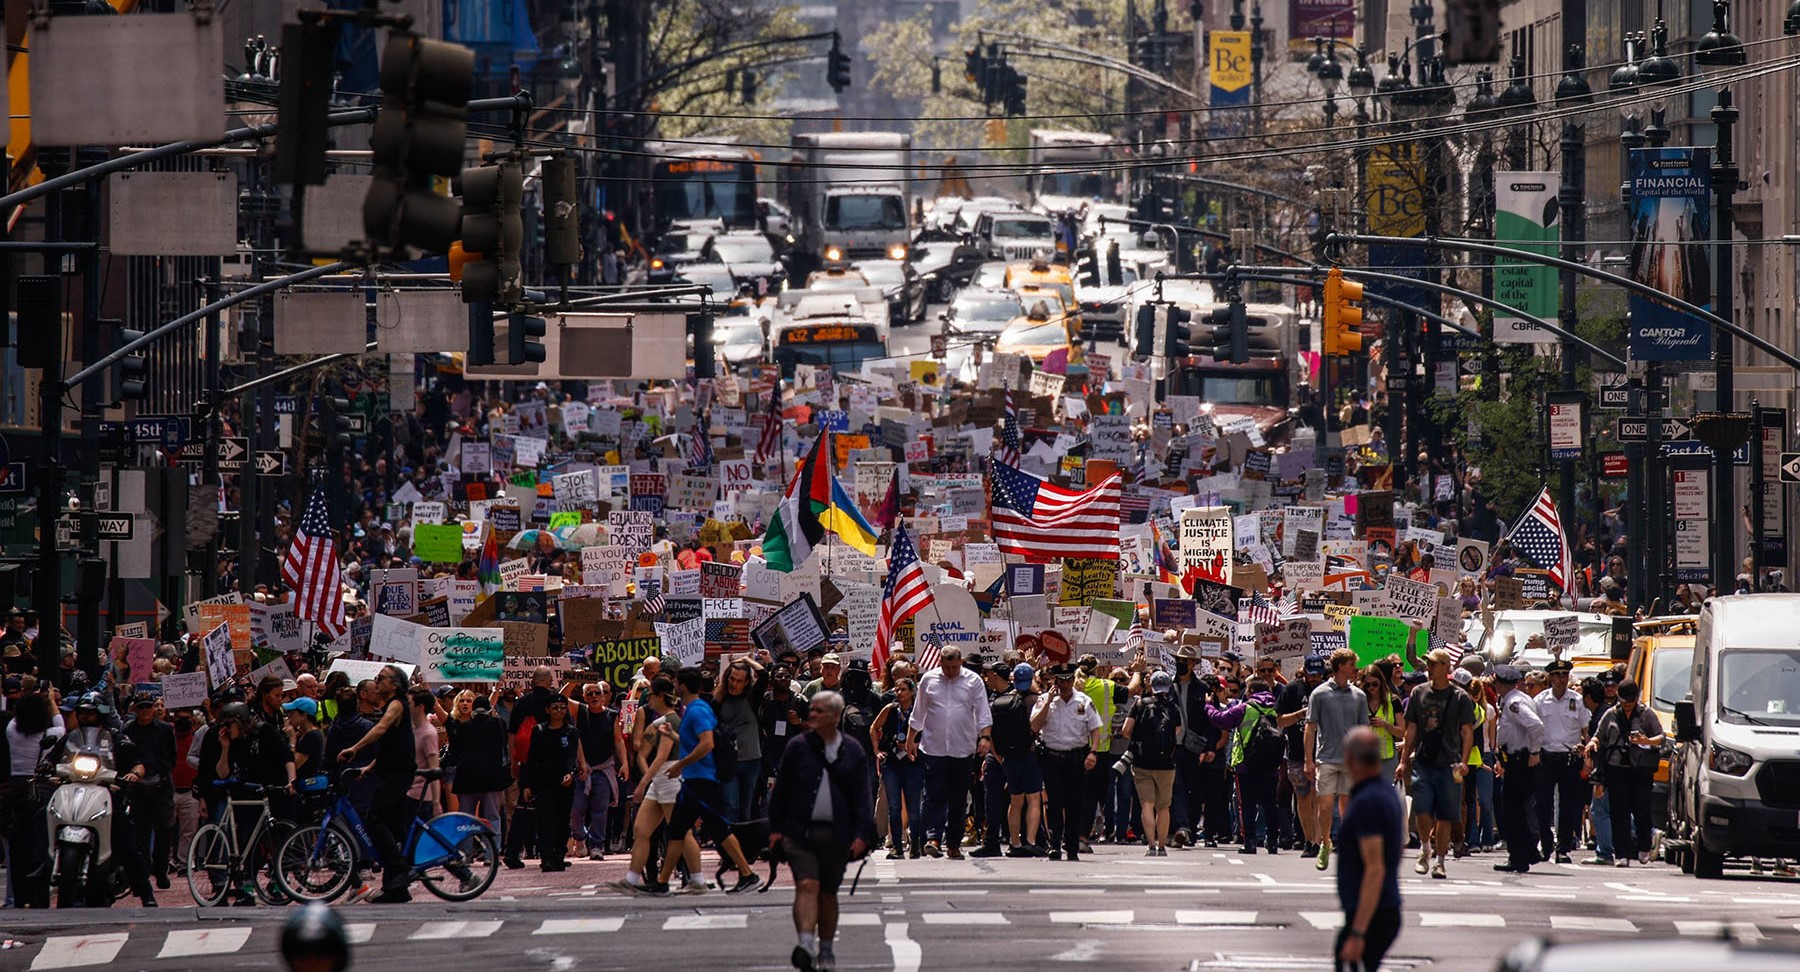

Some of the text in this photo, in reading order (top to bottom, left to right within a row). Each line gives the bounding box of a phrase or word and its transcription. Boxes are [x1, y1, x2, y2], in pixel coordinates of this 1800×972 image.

[1215, 48, 1246, 73] Be
[1636, 178, 1705, 188] FINANCIAL
[1636, 188, 1660, 197] Capital
[1379, 186, 1419, 216] Be
[1501, 267, 1528, 276] estate
[1501, 279, 1533, 290] capital
[1501, 291, 1527, 299] of the
[1508, 302, 1528, 311] orld
[1511, 322, 1541, 331] CBRE
[1640, 328, 1686, 338] CANTOR
[1652, 334, 1702, 350] Fitzgerald
[1608, 392, 1626, 401] ONE
[818, 410, 846, 420] STOP
[1552, 406, 1559, 415] 3
[1625, 425, 1646, 434] ONE
[182, 444, 233, 455] ONE AY
[726, 464, 750, 481] NO
[1677, 473, 1683, 482] 1
[561, 473, 588, 489] STOP
[687, 481, 712, 489] ELON
[569, 487, 593, 499] ICE
[100, 521, 126, 531] WAY
[1184, 519, 1228, 527] CLIMATE
[1678, 521, 1685, 530] 6
[1184, 529, 1228, 538] JUSTICE
[610, 534, 653, 547] DOES NOT
[1201, 539, 1211, 547] IS
[584, 550, 599, 561] ALL
[601, 549, 621, 559] YOU
[583, 561, 624, 572] FASCISTS
[1184, 558, 1228, 567] JUSTICE
[501, 562, 525, 575] BRING
[701, 562, 740, 579] NOBODY
[504, 568, 532, 582] ILMAR
[1083, 571, 1110, 580] healthy
[713, 576, 740, 589] ABOVE
[385, 585, 404, 595] DUE
[701, 586, 739, 598] THE LAW
[770, 586, 778, 596] IS
[1400, 587, 1419, 597] DUE
[387, 594, 411, 603] OCESS
[1390, 590, 1434, 607] PROCESS
[387, 602, 411, 611] TTERS
[704, 598, 738, 610] FREE
[427, 608, 445, 617] ump
[757, 606, 776, 616] THE
[1397, 604, 1433, 618] NOW!
[429, 615, 448, 623] scist
[1206, 618, 1217, 627] WE
[667, 618, 701, 639] PROTECT
[930, 621, 965, 631] EQUAL
[121, 626, 143, 637] WANTED
[280, 631, 299, 640] AGAIN
[896, 627, 914, 636] NOT
[1550, 626, 1577, 638] Dump
[428, 632, 498, 643] Our Power
[669, 636, 681, 648] OUR
[680, 629, 704, 645] TRANS
[920, 632, 979, 642] OORTUNITY
[1547, 635, 1578, 646] Trump
[428, 645, 491, 656] our Planet
[595, 638, 660, 663] ABOLISH
[670, 639, 705, 659] SIBLINGS
[1263, 642, 1304, 655] DEMOCRACY
[428, 660, 498, 671] our PEOPLE
[504, 659, 561, 667] THE NATIONAL
[165, 690, 181, 701] Free
